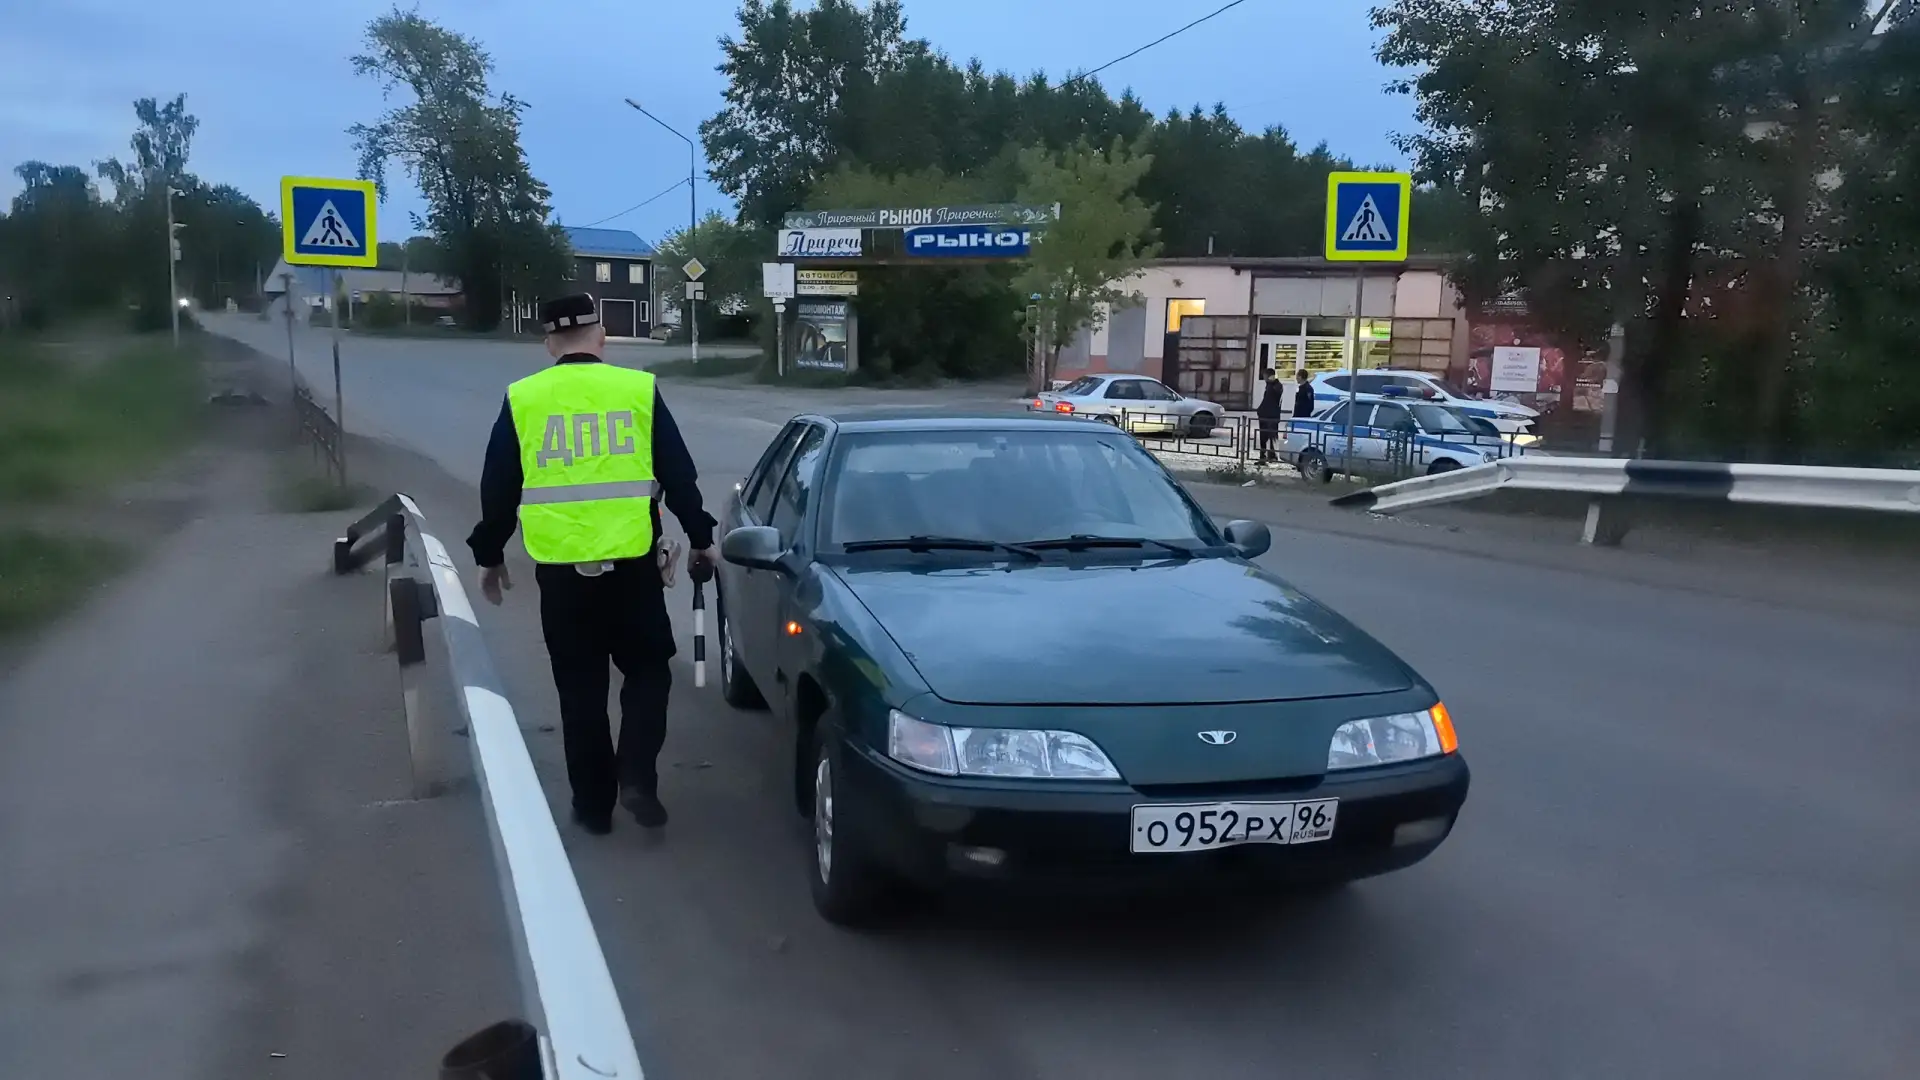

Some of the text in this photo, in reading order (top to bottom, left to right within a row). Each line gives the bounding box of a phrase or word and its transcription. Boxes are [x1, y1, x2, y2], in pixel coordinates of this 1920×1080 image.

[817, 211, 876, 227] Приречный
[879, 208, 933, 225] РЫНОК
[535, 410, 635, 468] ДПС
[1298, 804, 1326, 831] 96
[1292, 828, 1315, 841] RUS
